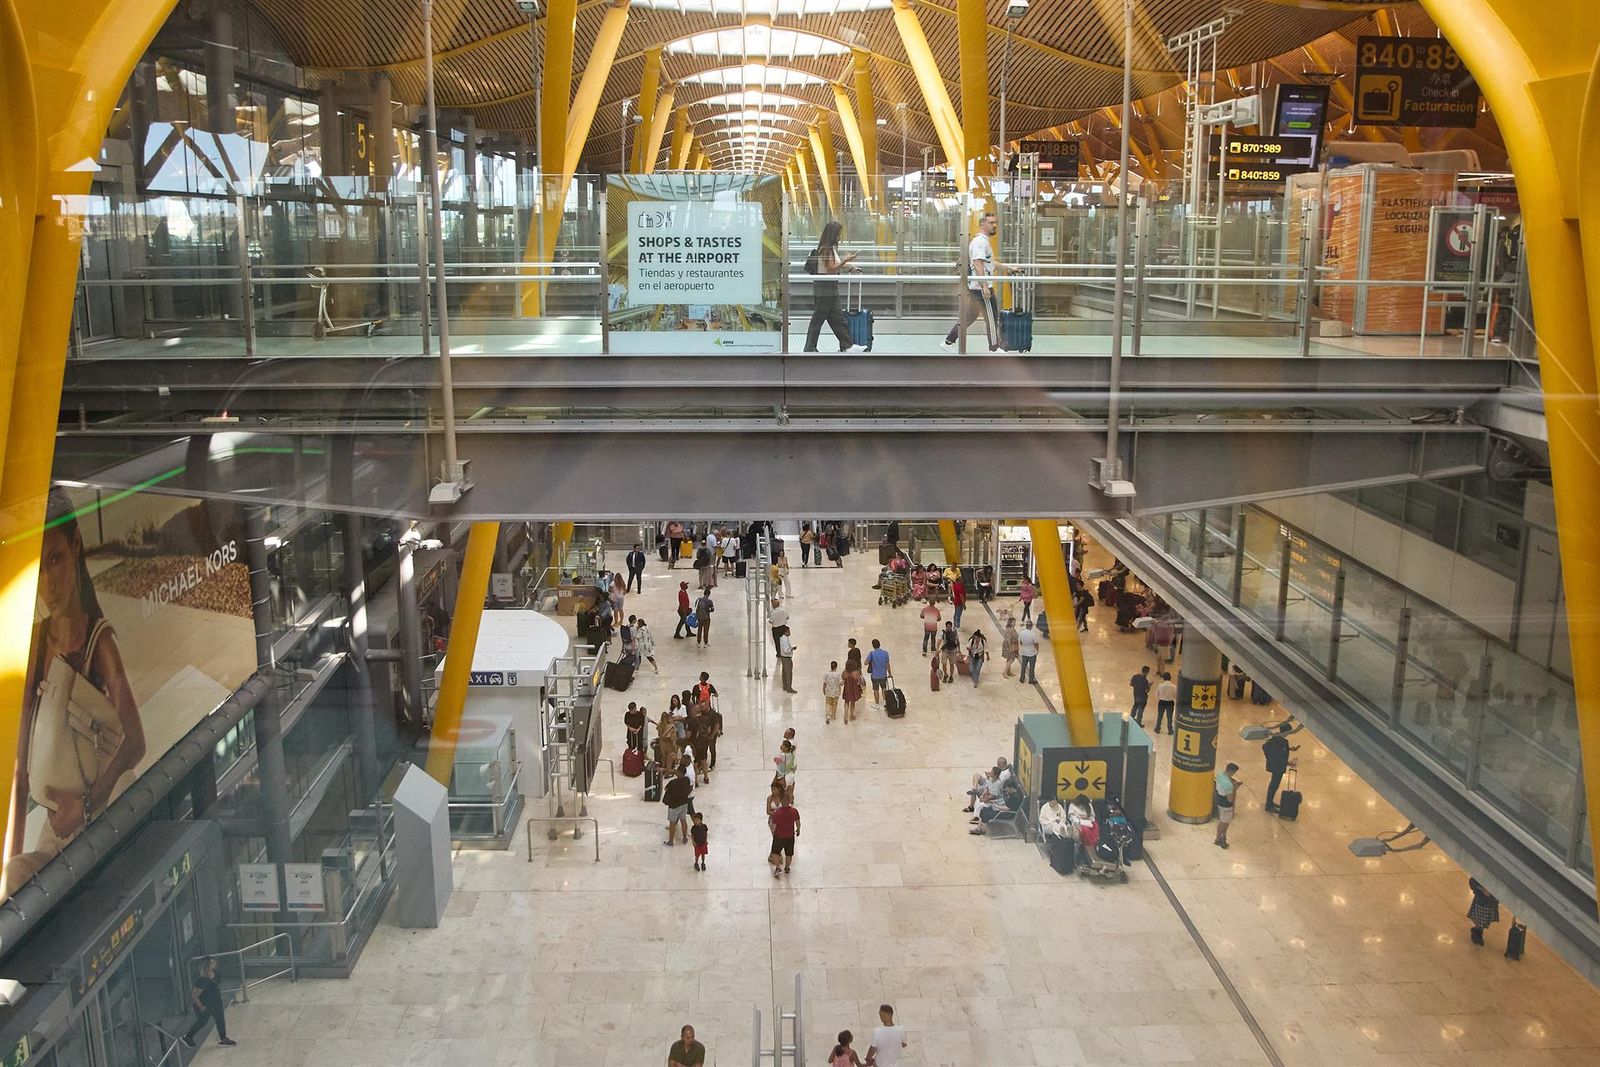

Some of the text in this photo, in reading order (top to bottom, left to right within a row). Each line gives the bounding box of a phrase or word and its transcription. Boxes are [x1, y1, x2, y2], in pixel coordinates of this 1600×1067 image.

[1361, 42, 1415, 69] 840
[1426, 43, 1460, 71] 85
[1421, 87, 1460, 98] Check-in
[1404, 99, 1474, 113] Facturación
[358, 122, 366, 160] 5
[1052, 144, 1078, 156] 889
[1242, 143, 1260, 153] 870
[1263, 143, 1282, 154] 989
[1241, 170, 1259, 180] 840
[1262, 171, 1280, 180] 859
[1385, 212, 1430, 220] LOCALIZAD
[638, 236, 742, 248] SHOPS & TASTES
[638, 252, 741, 264] AT THE AIRPORT
[638, 268, 744, 280] Tiendas y restaurantes
[638, 281, 715, 292] en el aeropuerto
[141, 539, 237, 620] MICHAEL KORS
[468, 673, 488, 684] AXI
